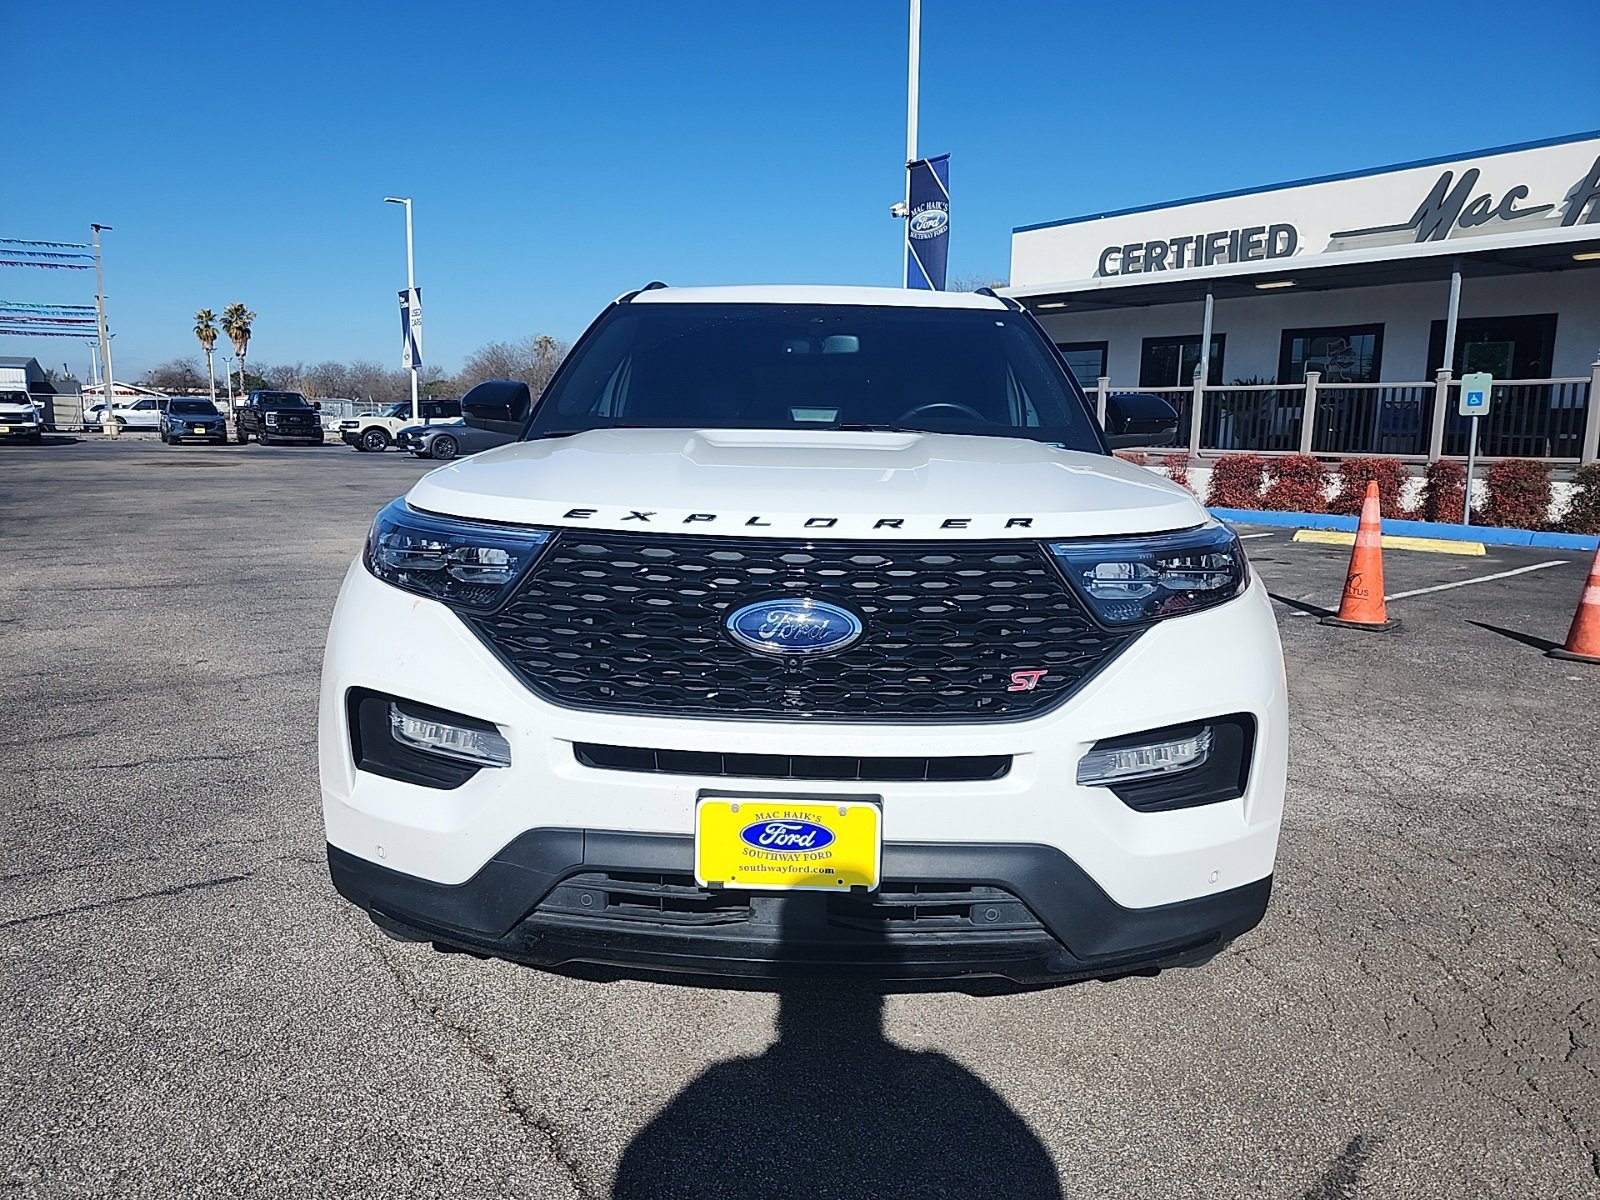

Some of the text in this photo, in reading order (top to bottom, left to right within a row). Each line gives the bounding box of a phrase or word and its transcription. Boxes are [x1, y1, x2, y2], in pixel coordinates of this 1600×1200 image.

[911, 201, 949, 217] MAC HAIK'S
[916, 214, 941, 230] Ford
[1099, 223, 1299, 277] CERTIFIED
[1330, 167, 1555, 243] Mac
[933, 225, 948, 238] FORD
[562, 508, 1035, 530] EXPLORER
[1345, 588, 1369, 597] LTUS
[758, 610, 831, 639] Ford
[1007, 669, 1048, 691] ST
[755, 811, 822, 823] MAC HAIK'S
[758, 823, 817, 847] Ford
[742, 848, 833, 862] SOUTHWAY FORD
[739, 864, 835, 875] southwayford.com
